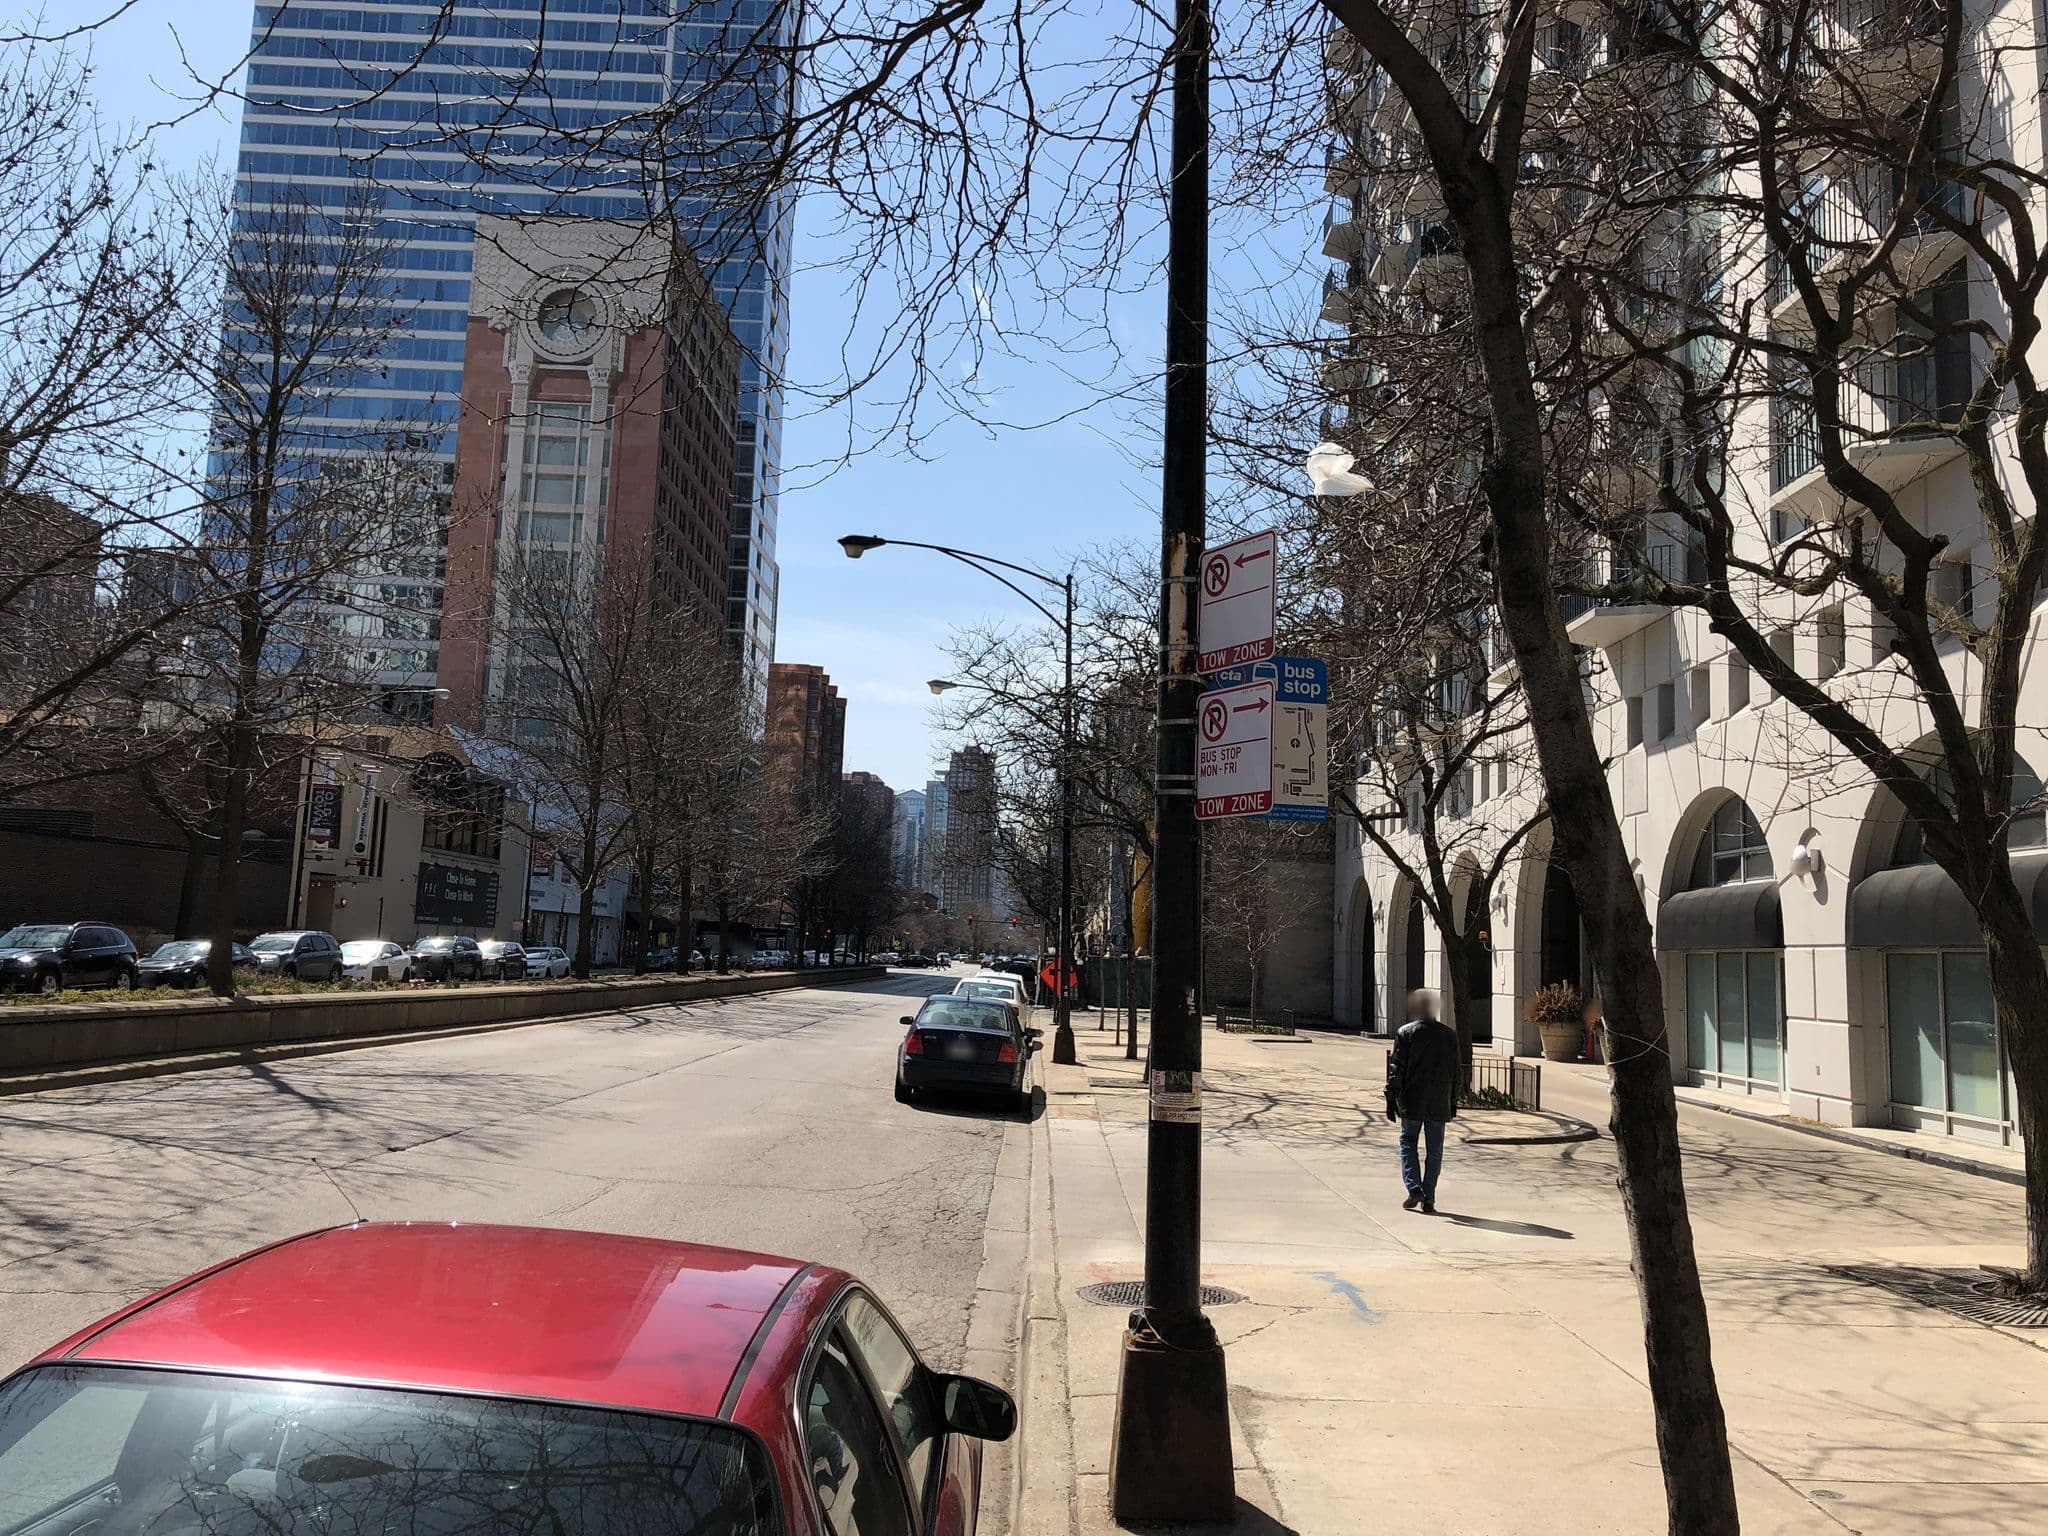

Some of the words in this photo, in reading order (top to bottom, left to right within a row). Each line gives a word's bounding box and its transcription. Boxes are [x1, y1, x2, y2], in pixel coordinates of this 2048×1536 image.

[1202, 650, 1227, 669] TOW
[1233, 641, 1266, 663] ZONE
[1220, 670, 1242, 681] cta
[1284, 662, 1315, 679] bus
[1284, 680, 1321, 698] stop
[1200, 750, 1217, 763] BUS
[1220, 746, 1242, 760] STOP
[1200, 798, 1225, 815] TOW
[1231, 794, 1265, 812] ZONE
